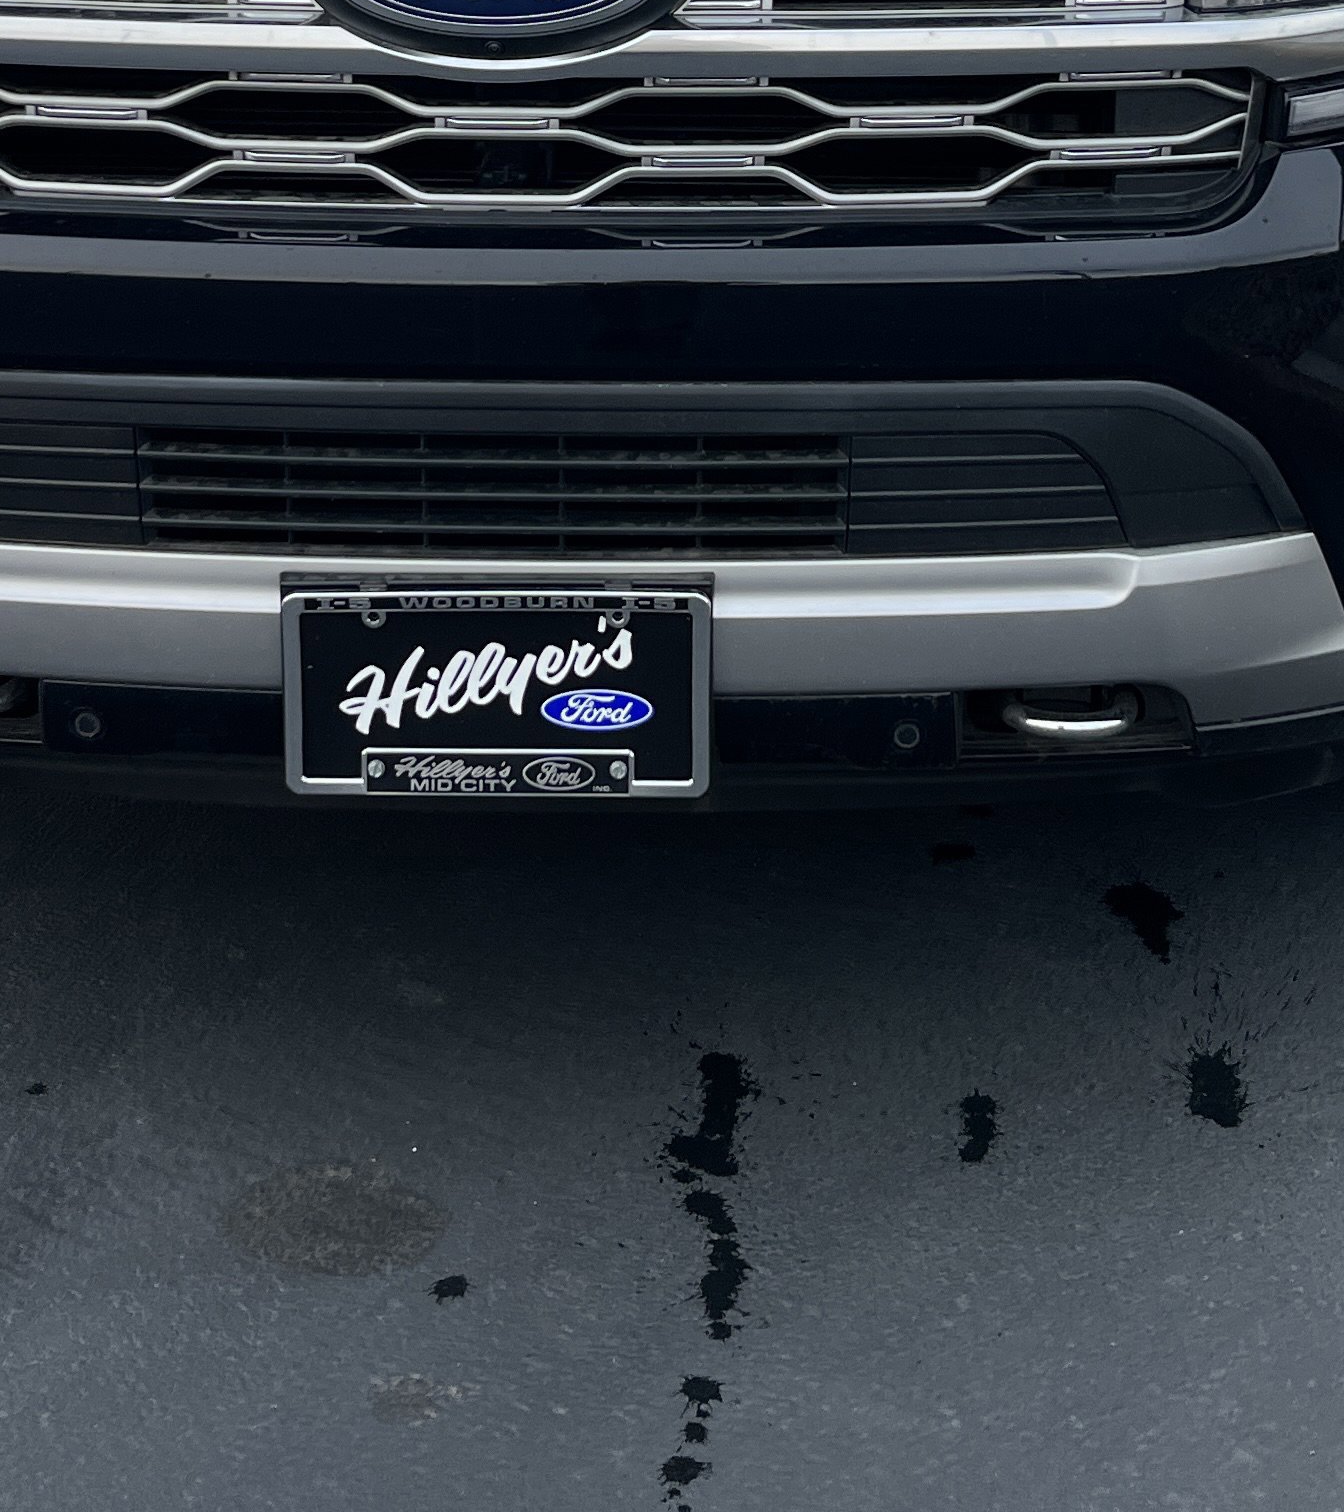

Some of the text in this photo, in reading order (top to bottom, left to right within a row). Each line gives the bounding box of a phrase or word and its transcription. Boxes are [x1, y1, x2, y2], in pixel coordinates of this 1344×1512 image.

[316, 596, 676, 610] I-5 WOODBURN I-5
[338, 615, 633, 735] Hillyer's
[559, 693, 632, 724] Ford
[394, 755, 513, 782] Hillyer's
[535, 759, 582, 785] Ford
[410, 779, 517, 792] MID CITY
